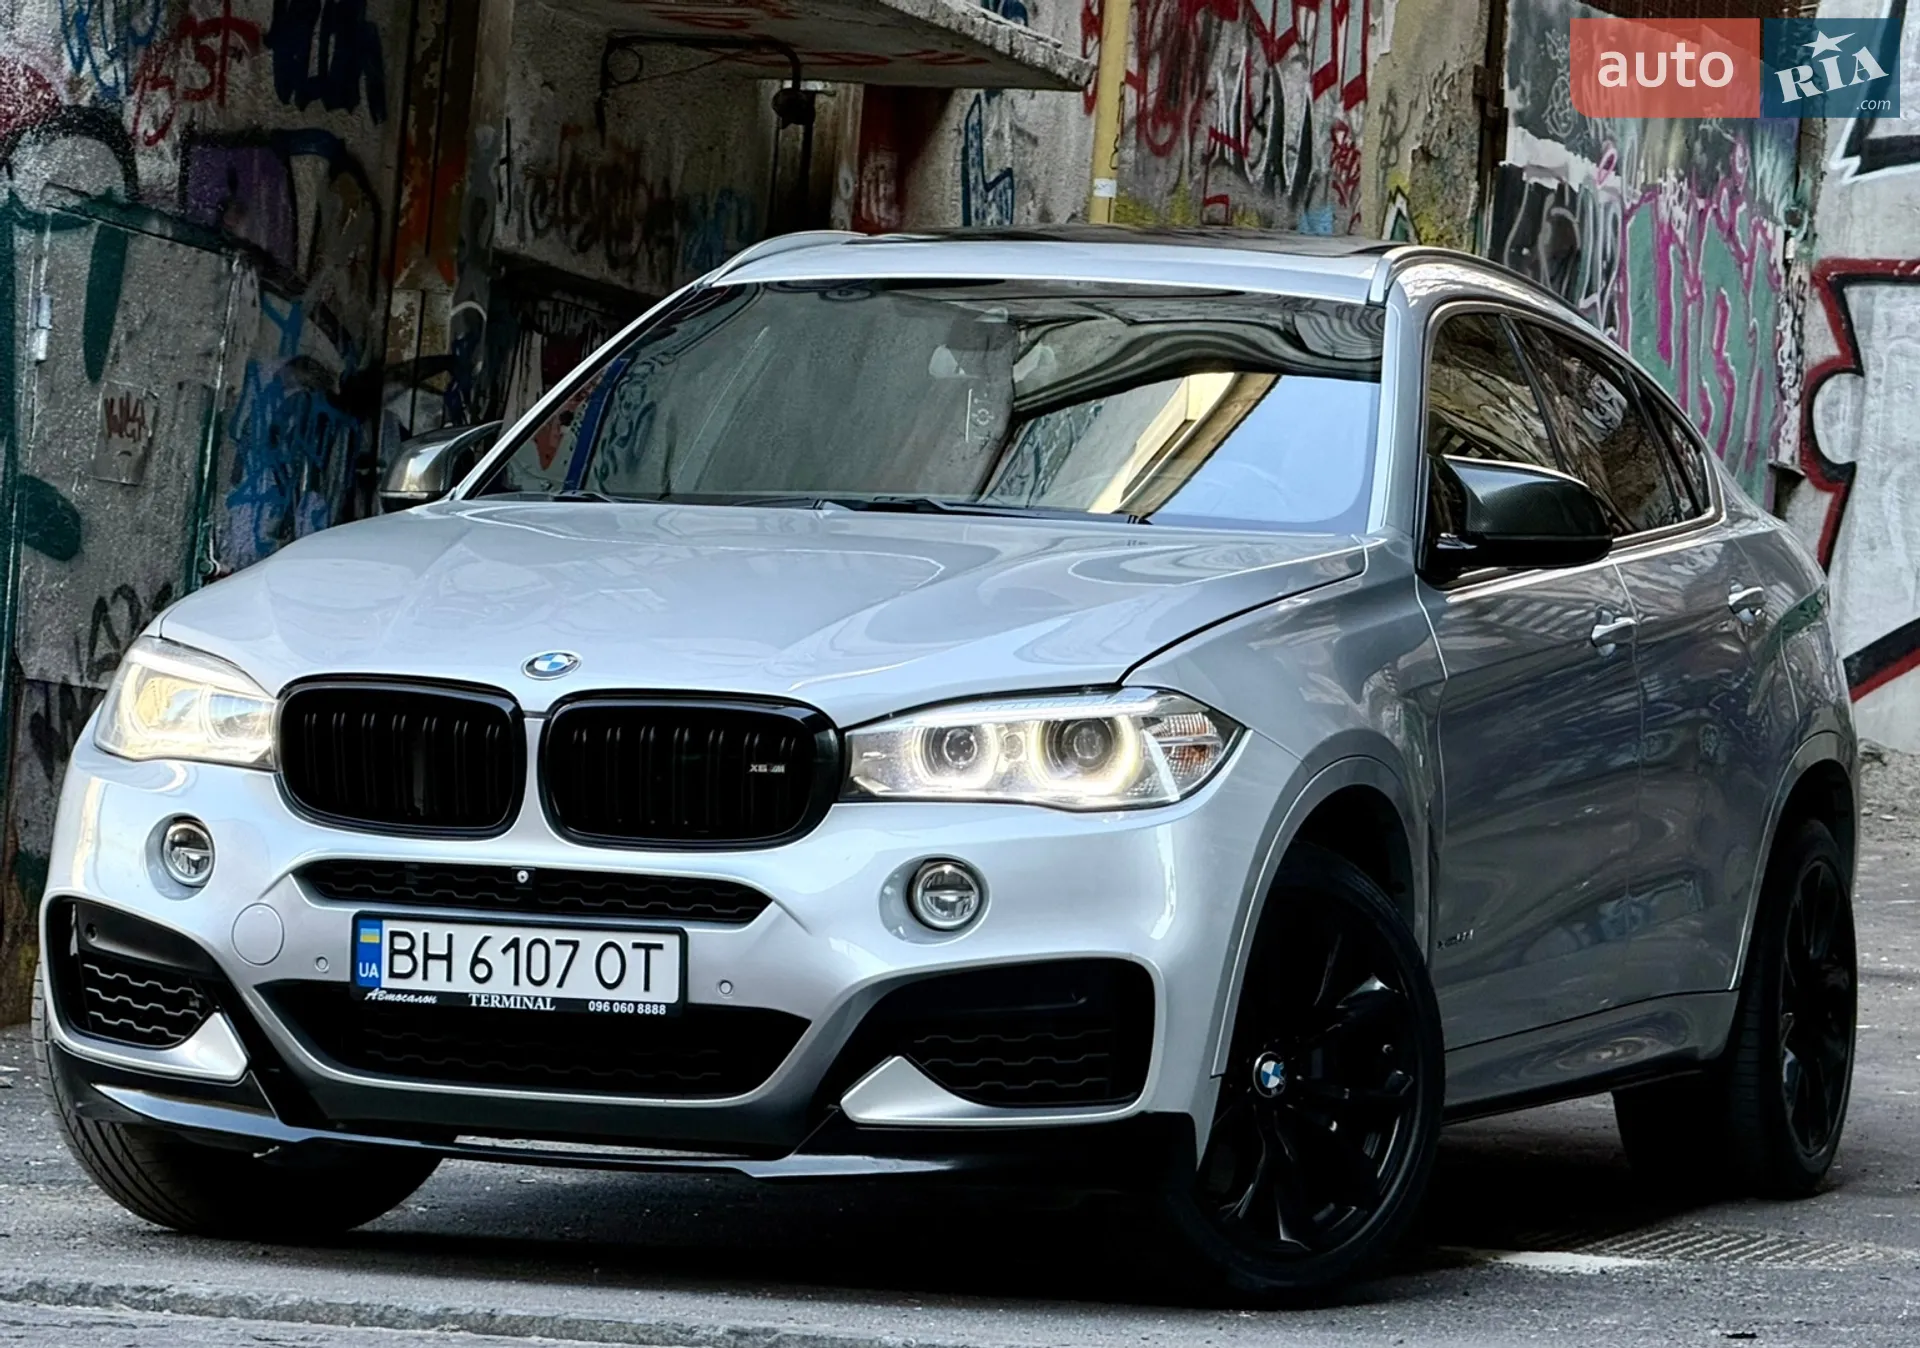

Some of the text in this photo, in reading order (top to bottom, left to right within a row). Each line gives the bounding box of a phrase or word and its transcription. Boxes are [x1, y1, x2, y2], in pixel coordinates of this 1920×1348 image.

[388, 929, 665, 992] BH 6107 OT
[359, 962, 379, 979] UA
[468, 992, 556, 1011] TERMINAL
[588, 1000, 667, 1015] 096 060 8888
